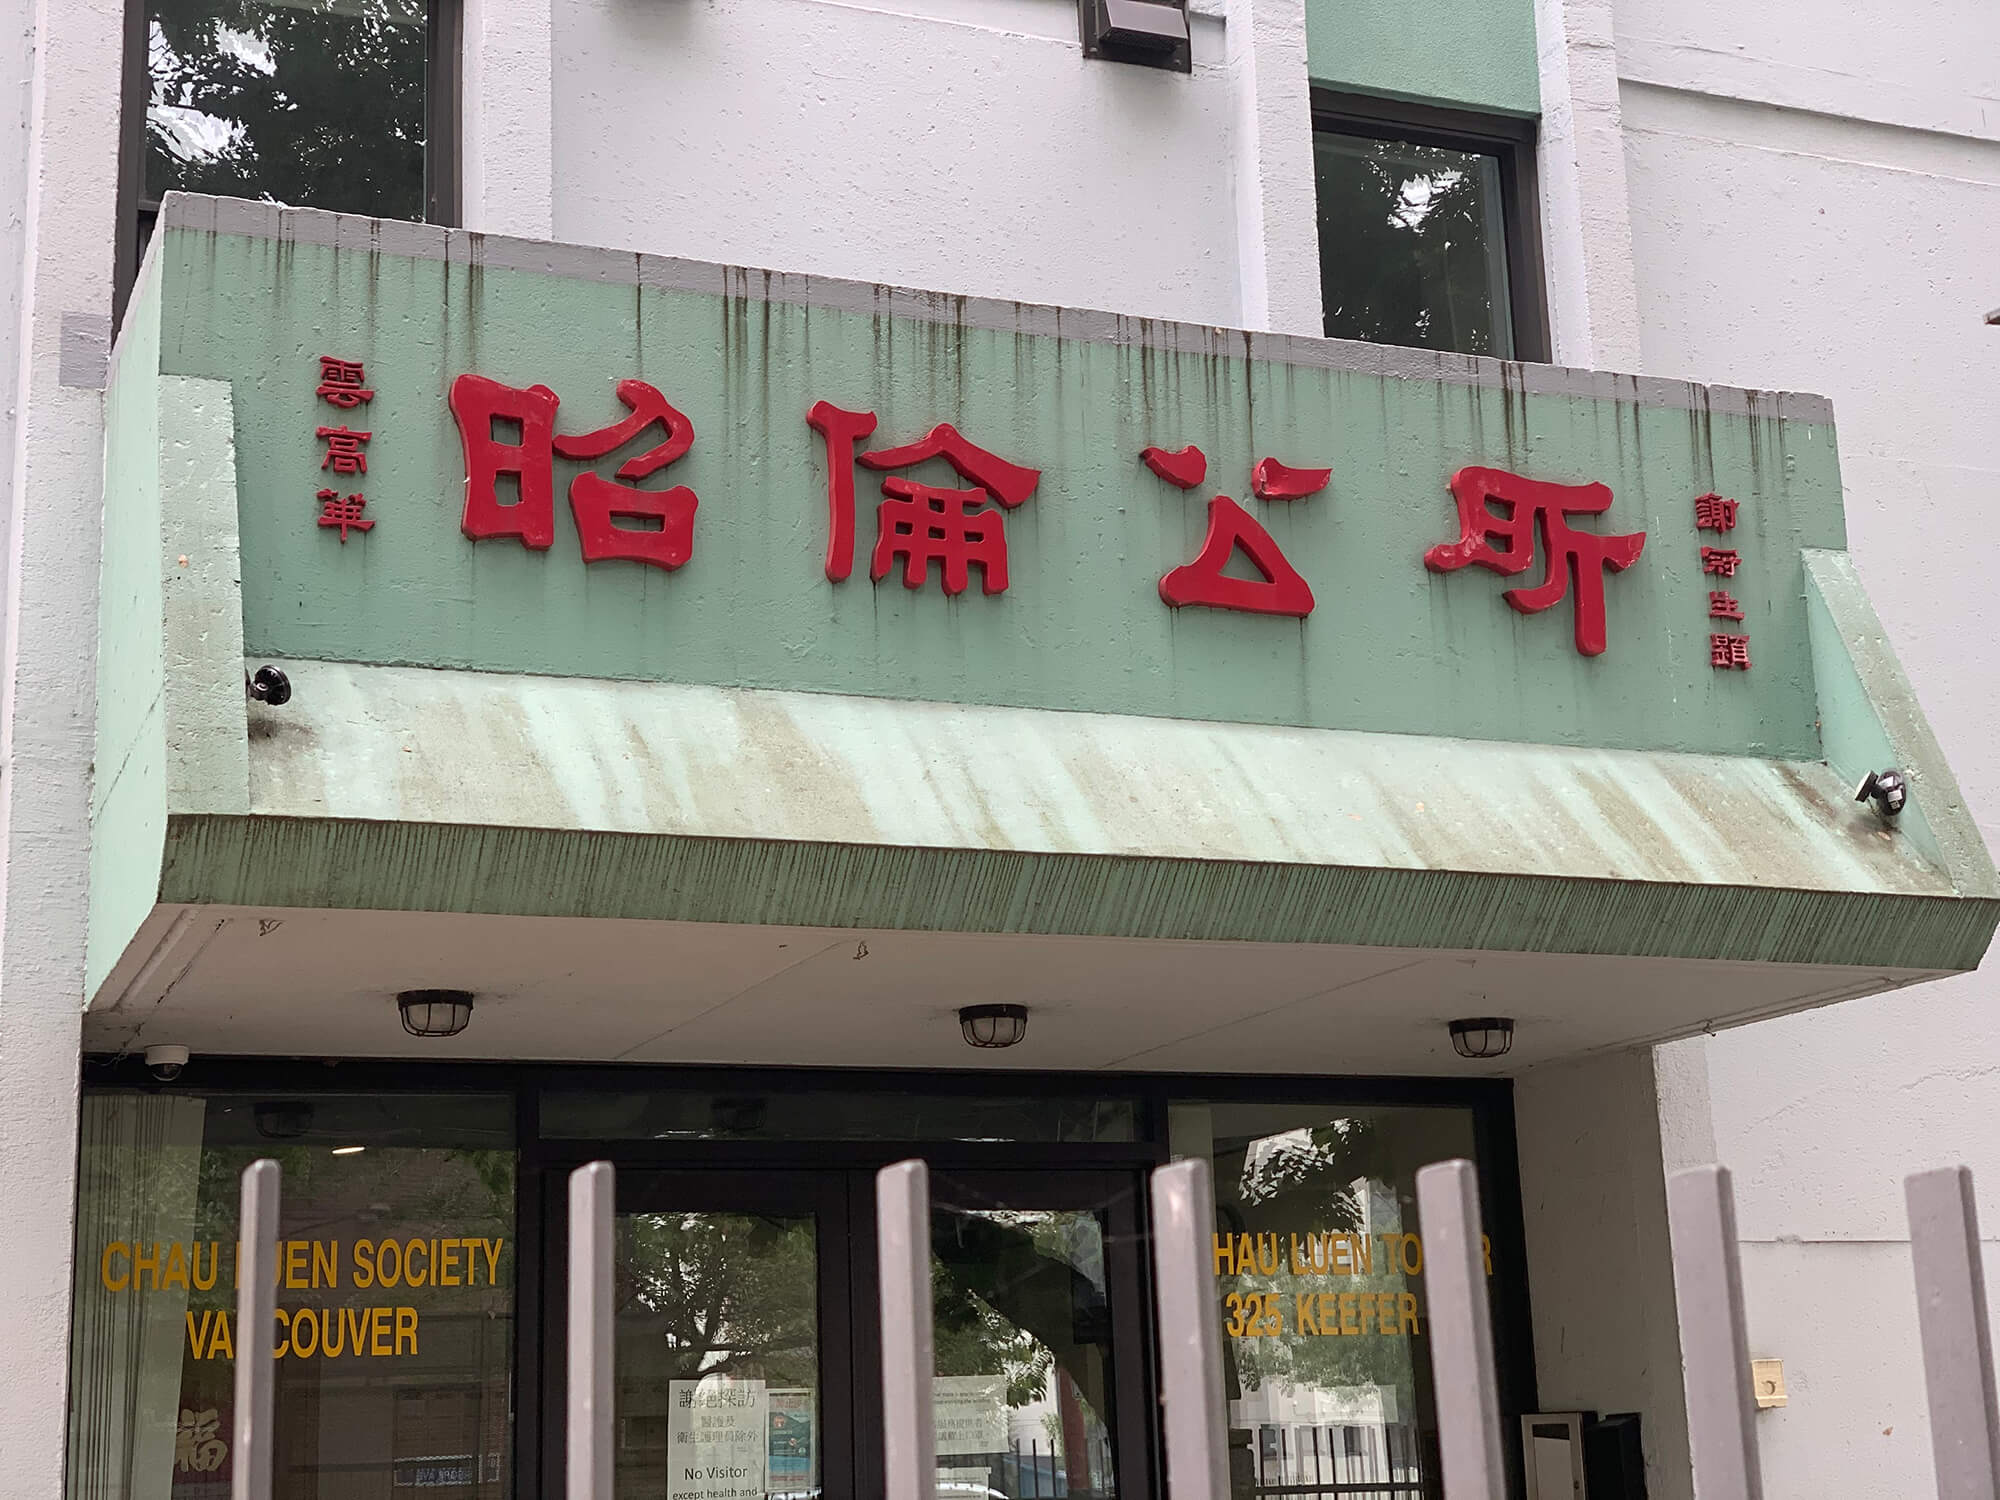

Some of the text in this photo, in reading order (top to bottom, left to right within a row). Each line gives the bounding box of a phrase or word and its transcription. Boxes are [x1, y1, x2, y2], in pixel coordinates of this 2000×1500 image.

[315, 355, 376, 543] 雲高華
[449, 373, 1647, 656] 昭倫公所
[101, 1238, 504, 1292] CHAU EN SOCIETY
[1211, 1231, 1493, 1276] HAU LUEN TOR
[186, 1307, 419, 1360] VACOUVER
[1225, 1291, 1420, 1337] 325 KEEFER
[672, 1486, 758, 1500] except health and
[684, 1465, 748, 1480] No Visitor
